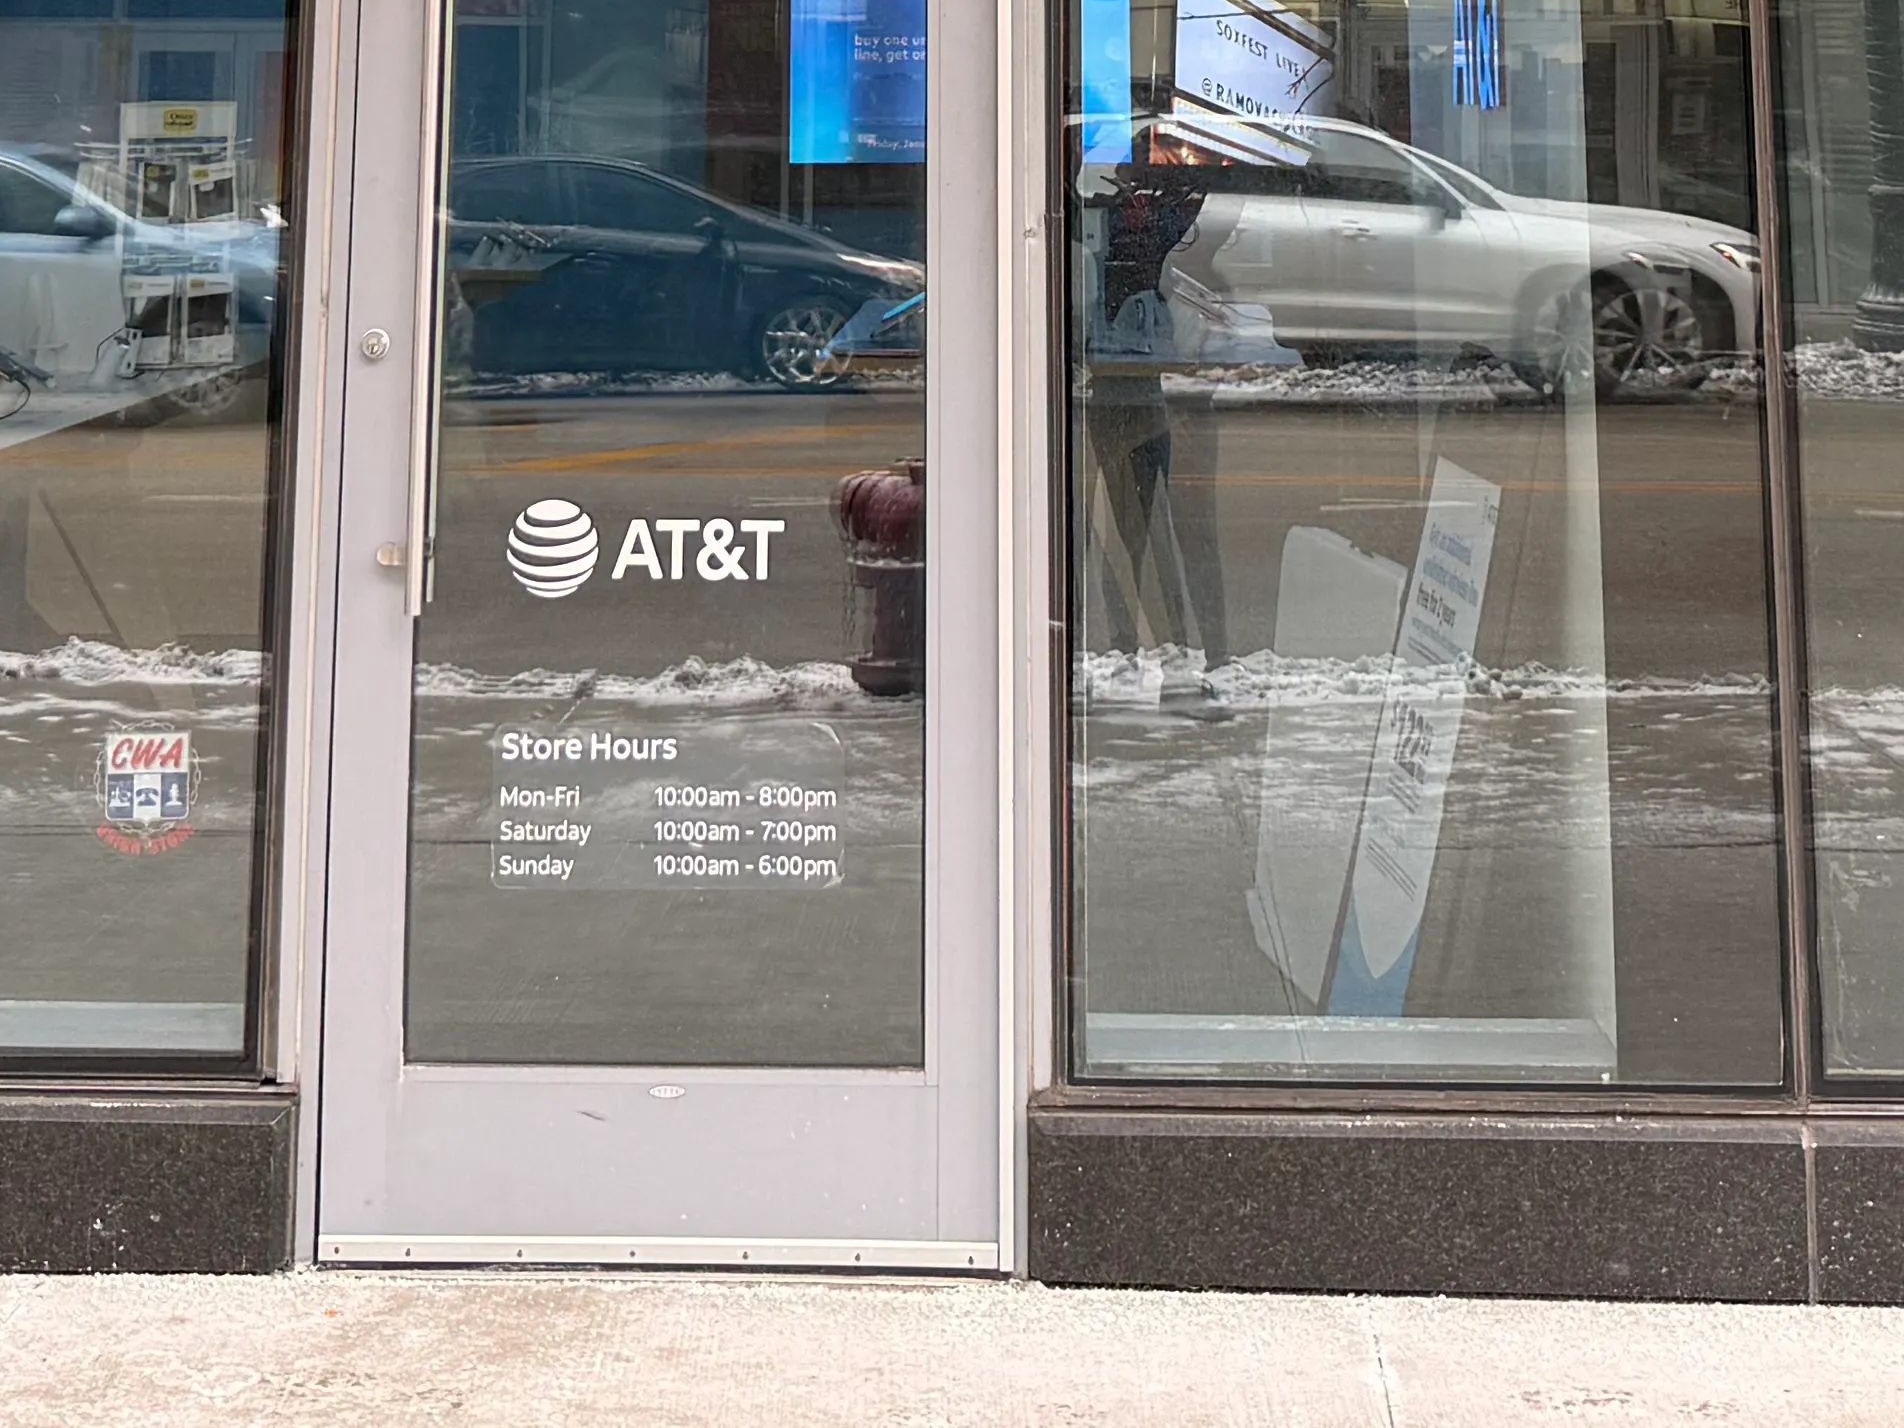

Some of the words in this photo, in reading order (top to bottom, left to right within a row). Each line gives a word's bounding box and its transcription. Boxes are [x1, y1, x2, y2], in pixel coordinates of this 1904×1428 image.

[854, 33, 881, 51] buy
[883, 35, 909, 46] one
[886, 49, 910, 63] get
[610, 518, 786, 581] AT&T
[110, 737, 185, 771] CWA
[502, 732, 583, 761] Store
[590, 732, 678, 761] Hours
[499, 785, 581, 808] Mon-Fri
[654, 785, 741, 808] 10:00am
[758, 785, 837, 812] 8:00pm
[499, 820, 592, 846] Saturday
[653, 820, 741, 843] 10:00am
[760, 820, 837, 846] 7:00pm
[498, 855, 575, 880] Sunday
[653, 855, 740, 877] 10:00am
[758, 855, 837, 881] 6:00pm
